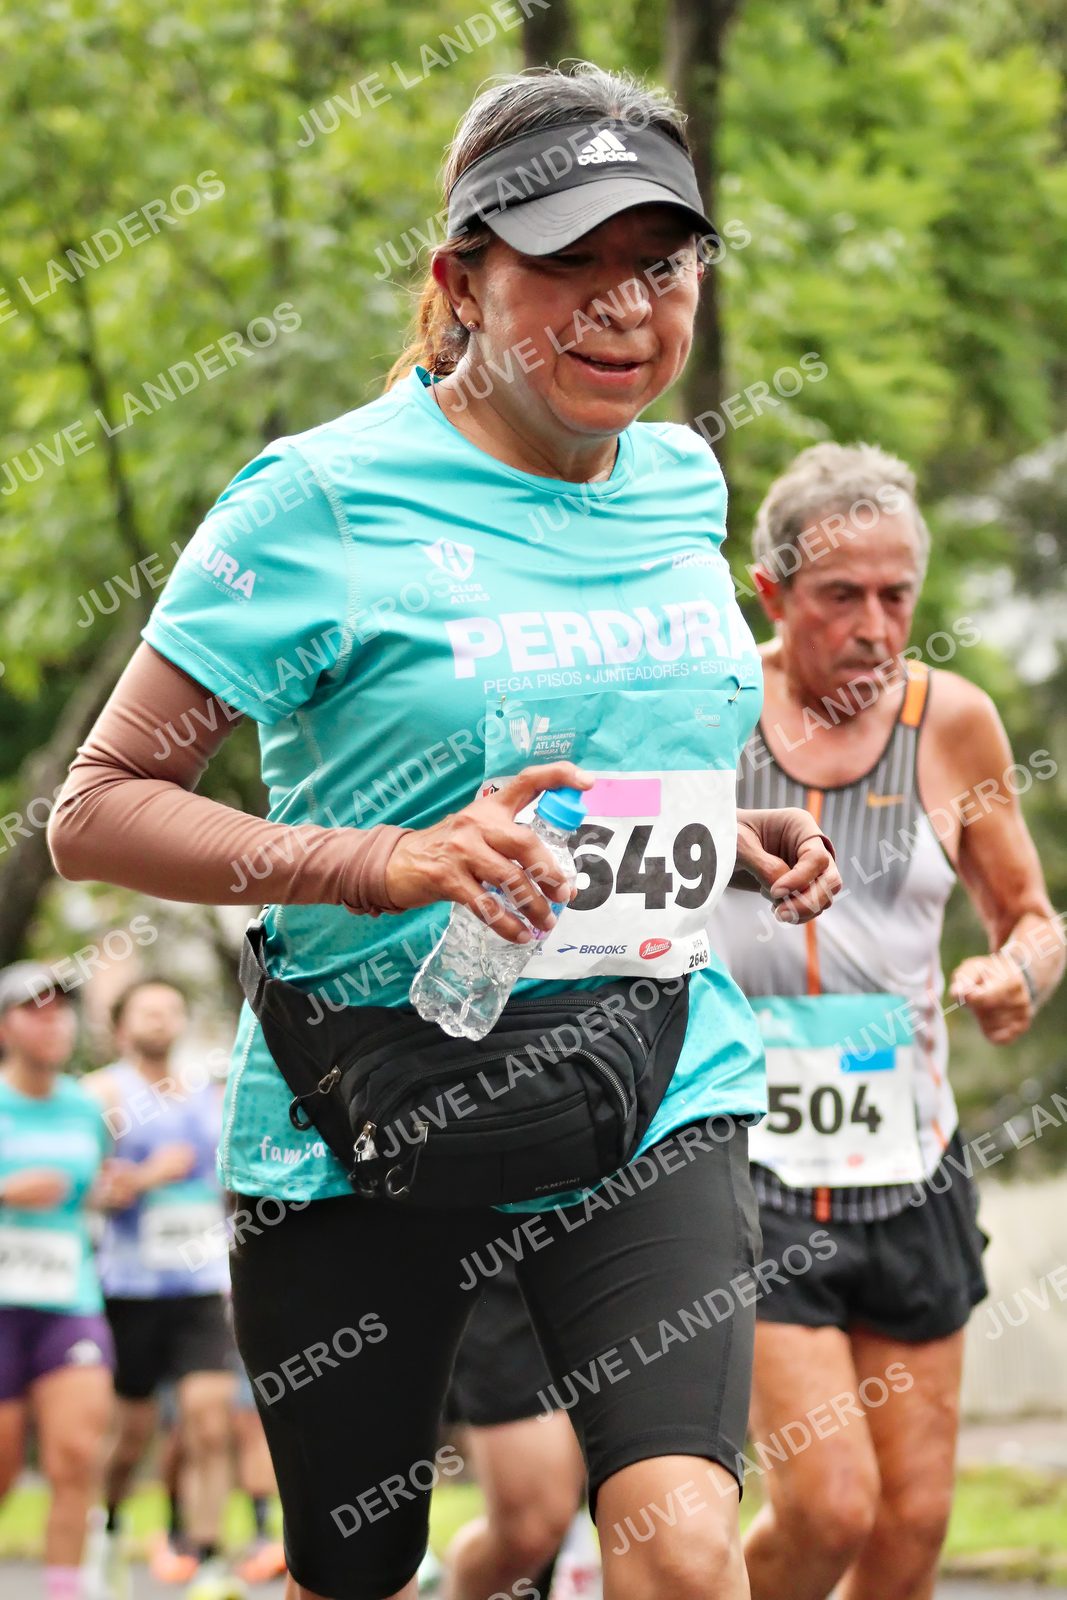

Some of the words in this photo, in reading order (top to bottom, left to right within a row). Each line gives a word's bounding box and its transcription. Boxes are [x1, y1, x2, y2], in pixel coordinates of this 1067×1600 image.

[578, 149, 638, 165] adidas
[451, 583, 482, 594] CLUB
[450, 592, 491, 605] ATLAS
[444, 599, 762, 680] PERDURA
[484, 677, 533, 694] PEGA
[538, 671, 582, 688] PISOS
[593, 662, 689, 684] JUNTEADORES
[535, 740, 561, 750] ATLAS
[567, 823, 718, 911] 649
[579, 944, 628, 954] BROOKS
[688, 949, 708, 968] 2649
[766, 1084, 883, 1135] 504
